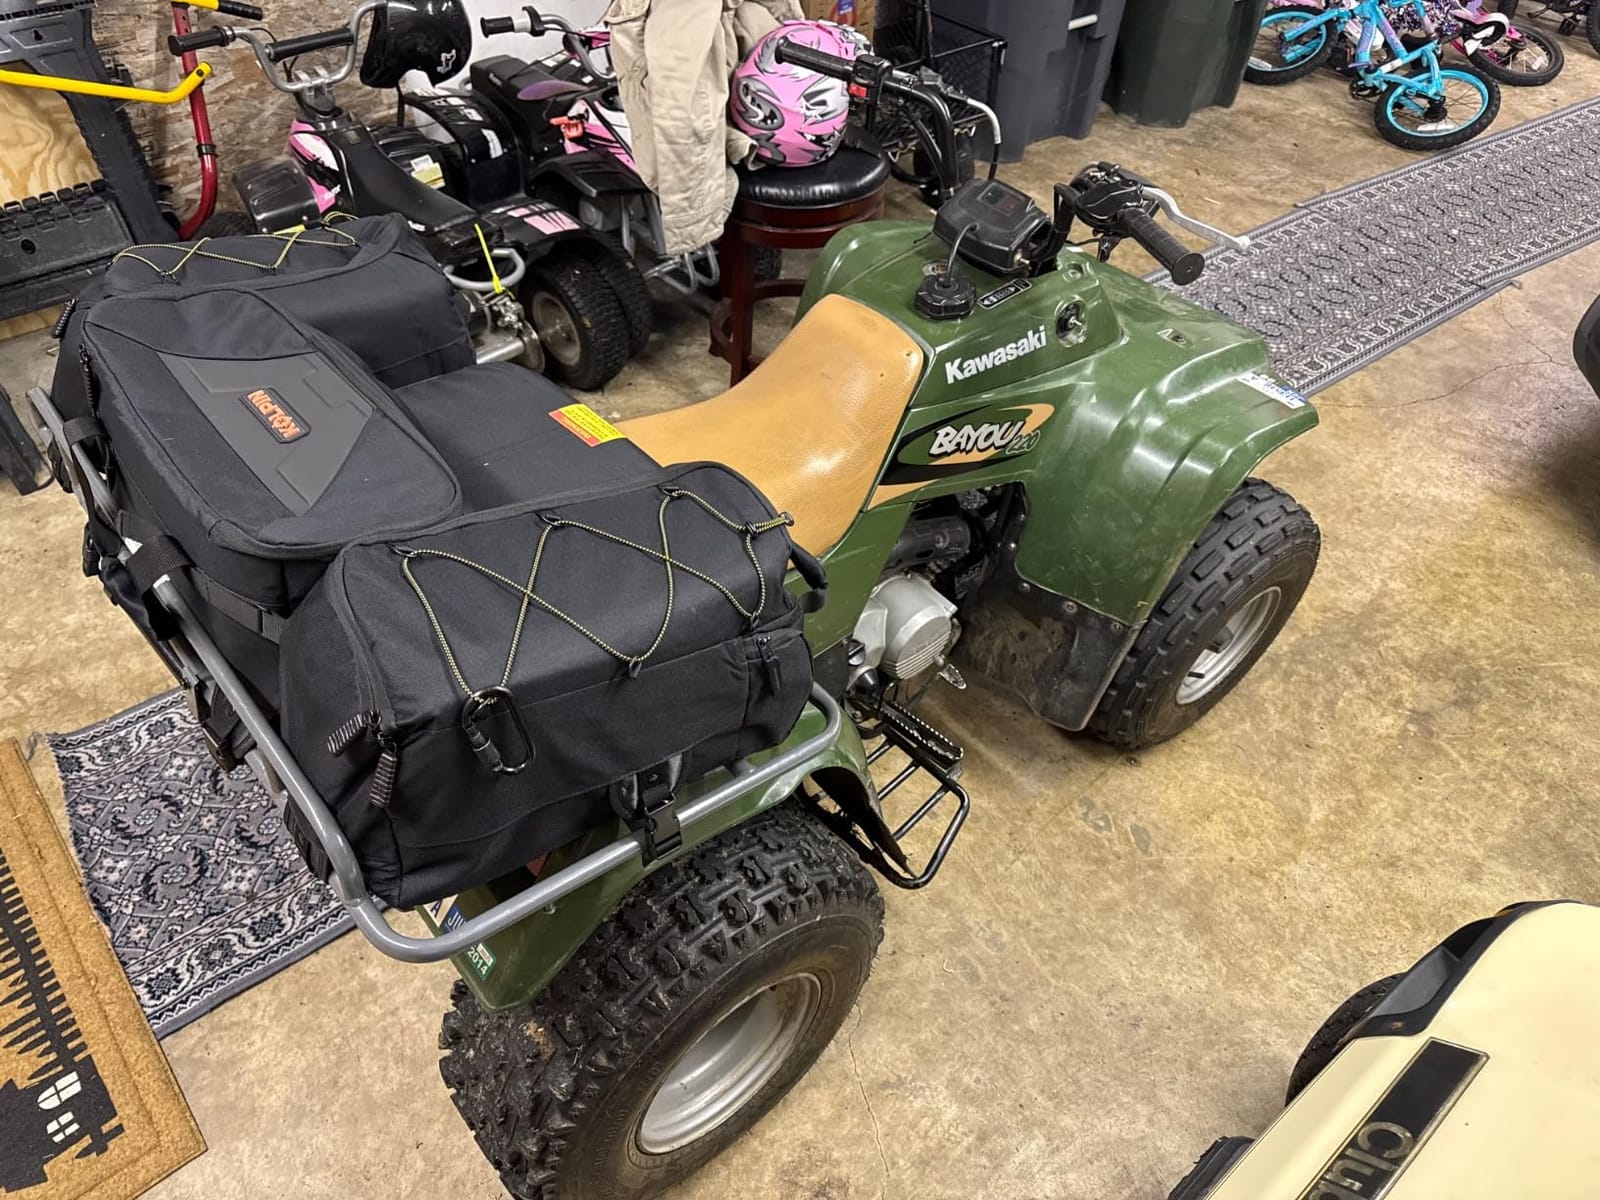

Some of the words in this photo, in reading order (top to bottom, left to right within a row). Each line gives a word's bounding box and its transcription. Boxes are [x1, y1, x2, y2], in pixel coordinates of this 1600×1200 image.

[945, 325, 1047, 384] Kawasaki
[247, 389, 300, 438] KOLPIN
[928, 421, 1025, 457] BAYOU
[1005, 429, 1041, 455] 220
[467, 946, 489, 975] 2014
